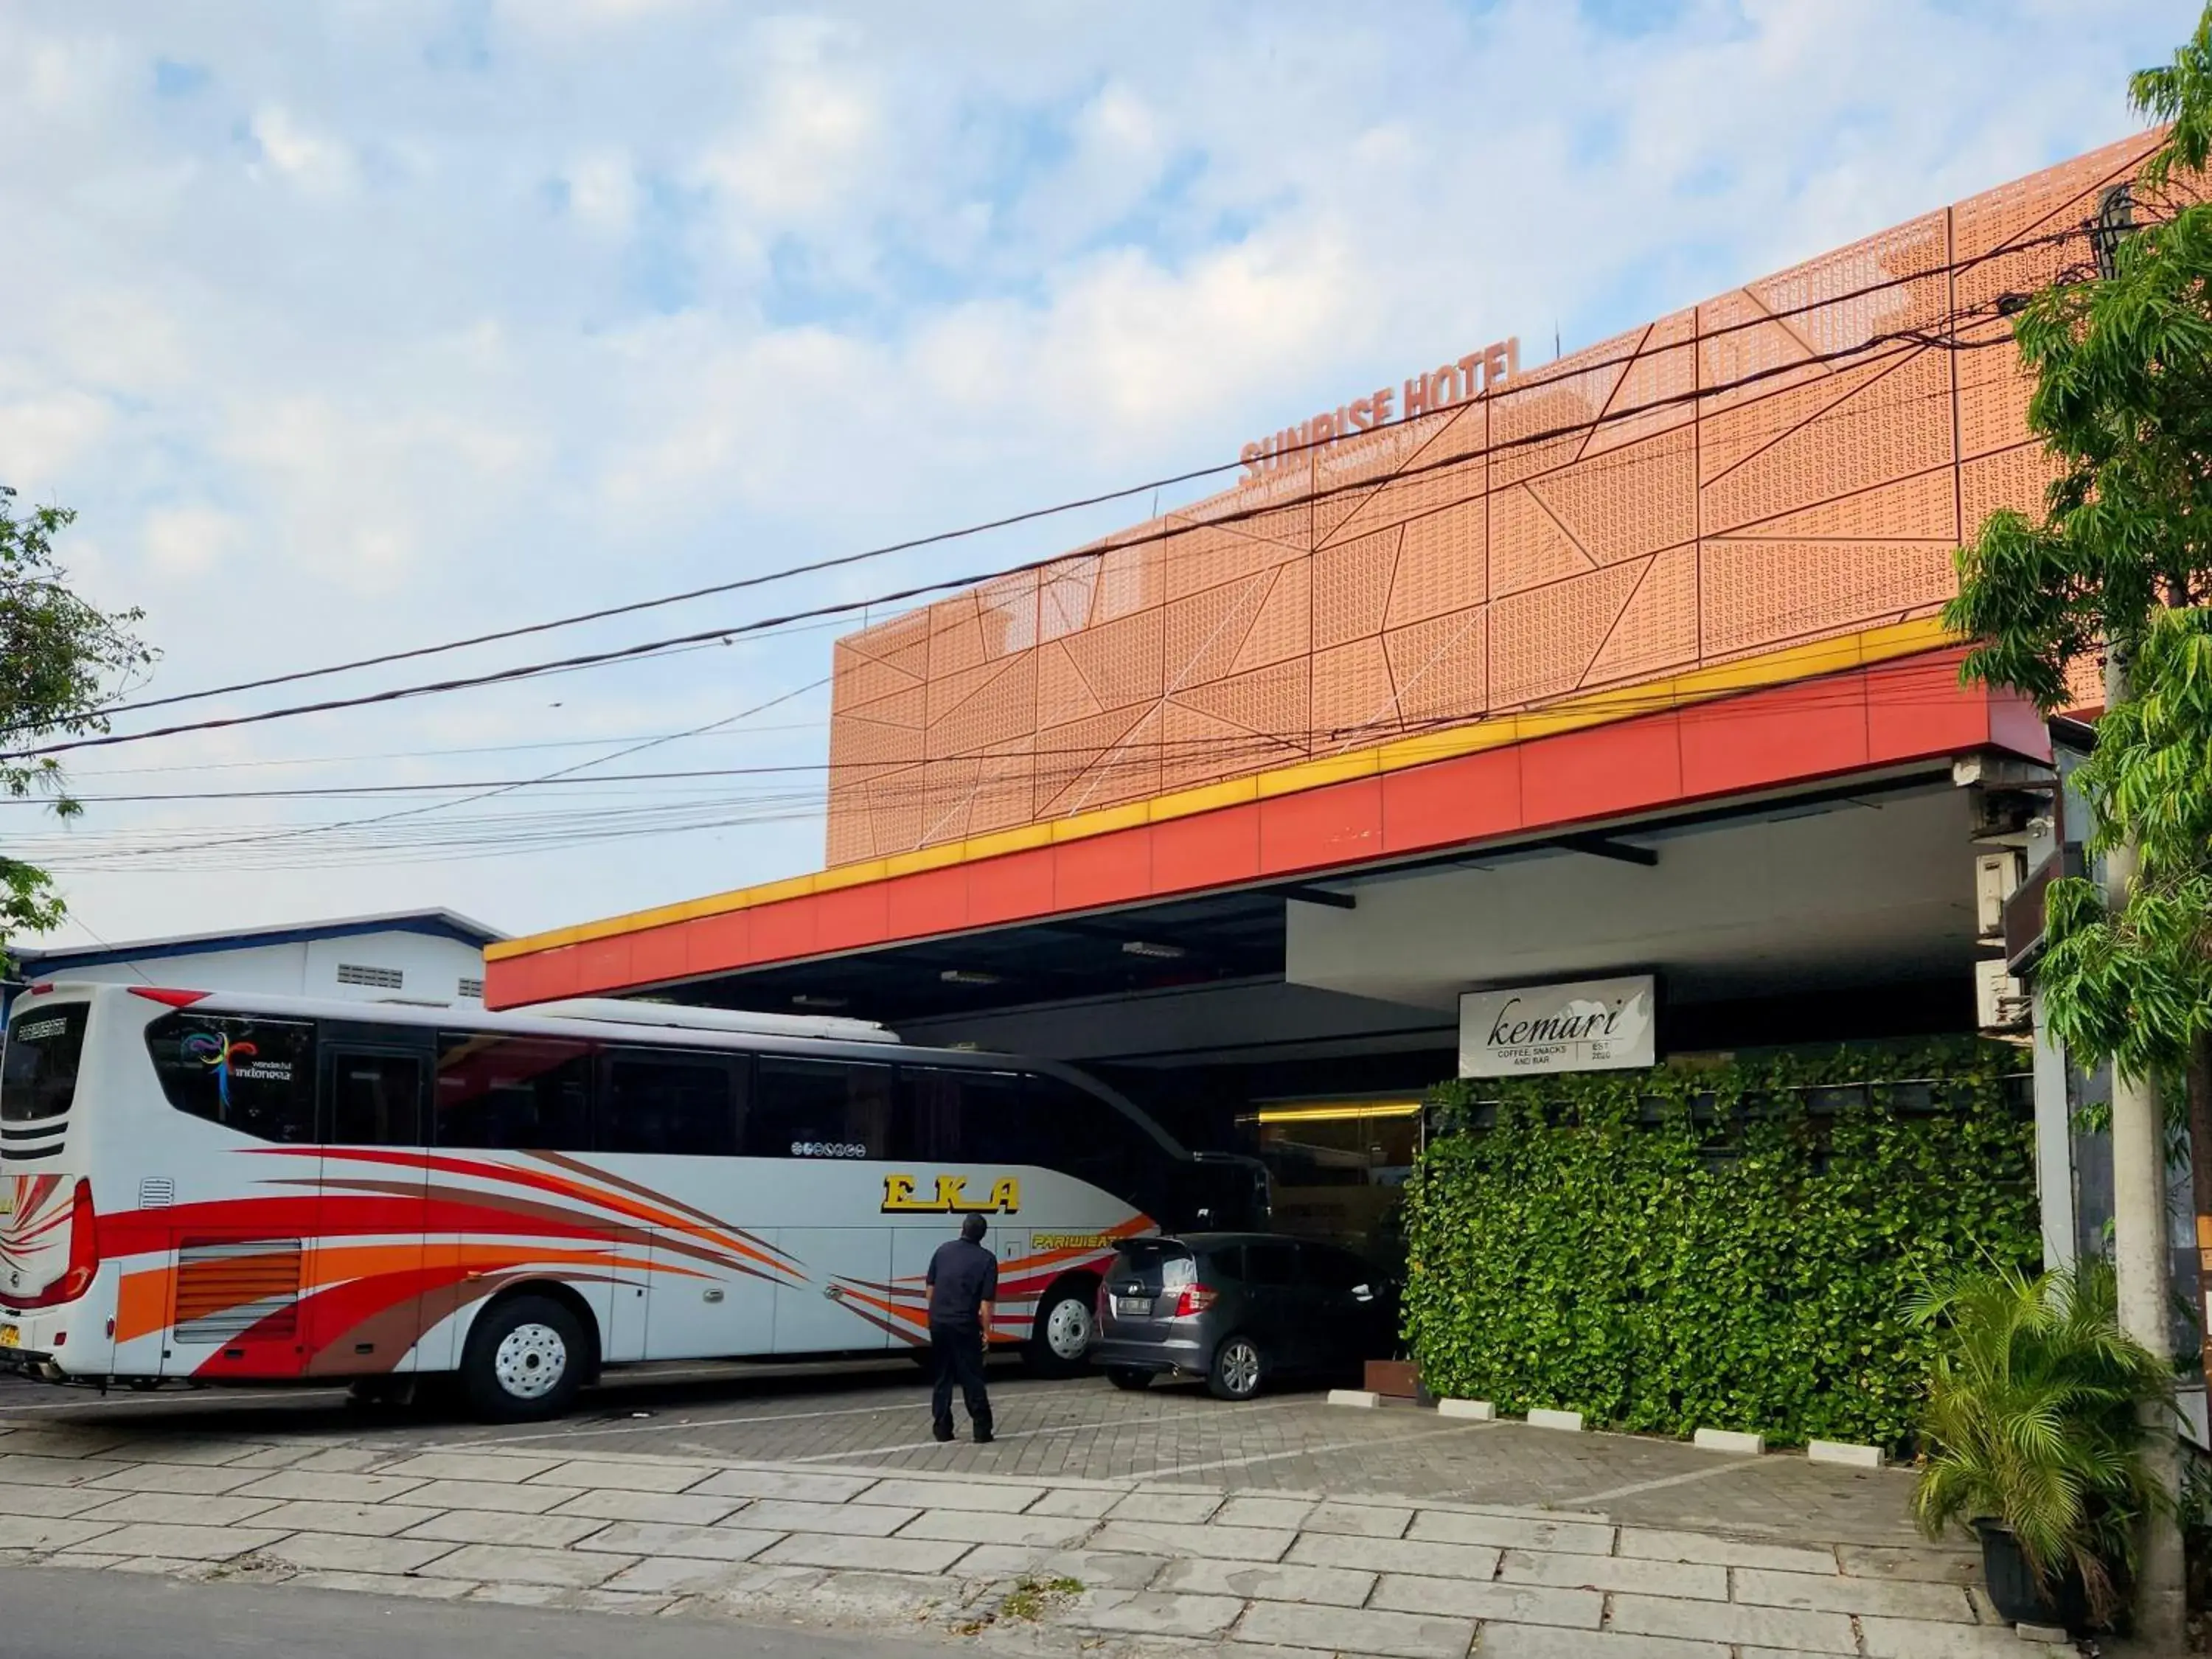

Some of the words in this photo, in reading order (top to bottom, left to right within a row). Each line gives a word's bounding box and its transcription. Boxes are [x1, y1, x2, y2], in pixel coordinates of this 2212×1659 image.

[1239, 386, 1395, 486] SUNRISE
[1487, 998, 1622, 1047] kemari
[1514, 1057, 1531, 1065] AND
[1532, 1056, 1549, 1064] BAR
[1533, 1046, 1567, 1055] SNACKS
[880, 1174, 1020, 1214] EKA
[1031, 1234, 1123, 1249] PARIWISAT
